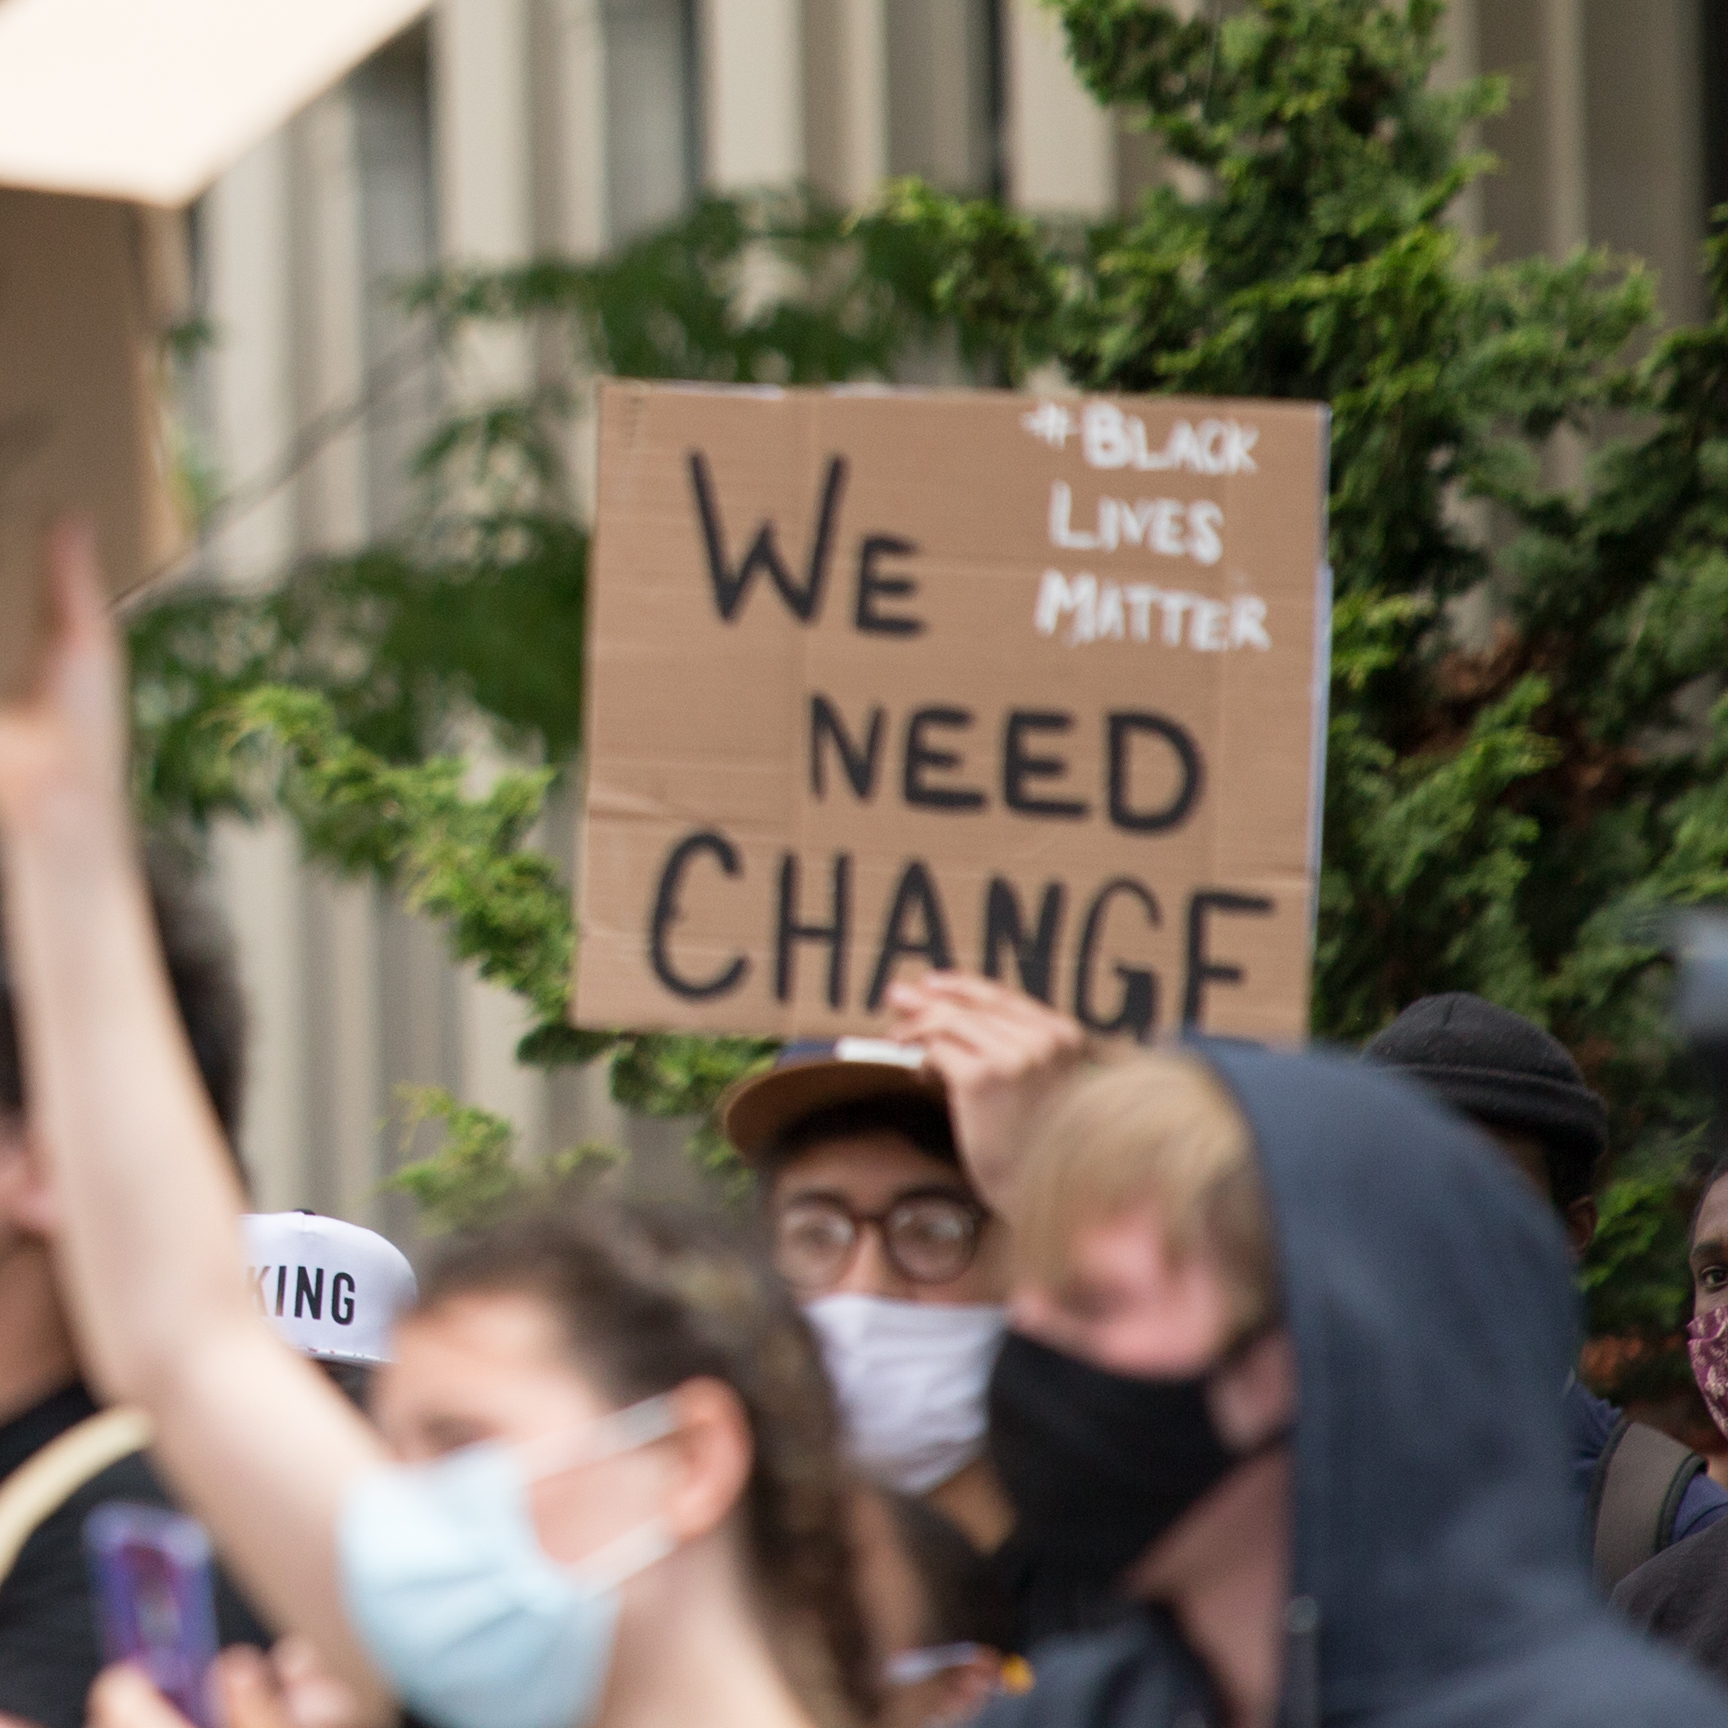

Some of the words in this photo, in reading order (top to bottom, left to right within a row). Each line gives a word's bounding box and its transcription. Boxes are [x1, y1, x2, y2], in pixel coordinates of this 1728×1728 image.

[1022, 402, 1261, 475] #BLACK
[1048, 483, 1224, 564] LIVES
[1034, 570, 1272, 652] MATTER
[808, 690, 1206, 833] NEED
